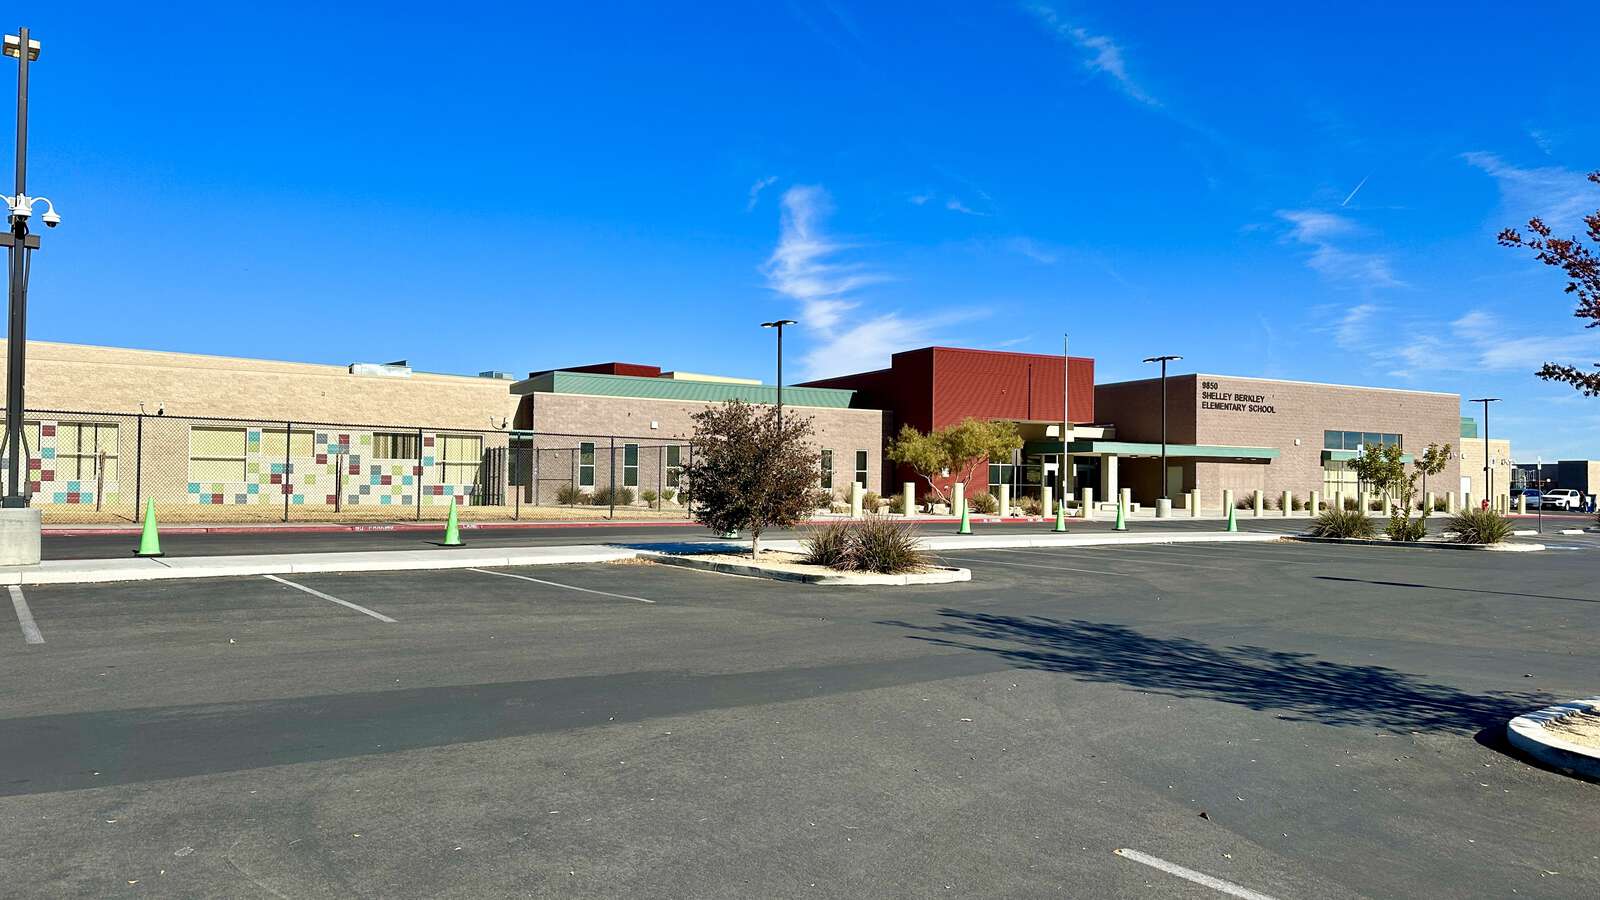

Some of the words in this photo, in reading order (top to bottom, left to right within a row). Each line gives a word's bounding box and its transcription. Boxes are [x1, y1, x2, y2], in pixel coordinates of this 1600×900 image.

[1202, 381, 1218, 390] 9850
[1202, 391, 1232, 401] SHELLEY
[1234, 393, 1265, 403] BERKLEY
[1202, 401, 1246, 412] ELEMENTARY
[1249, 404, 1276, 413] SCHOOL
